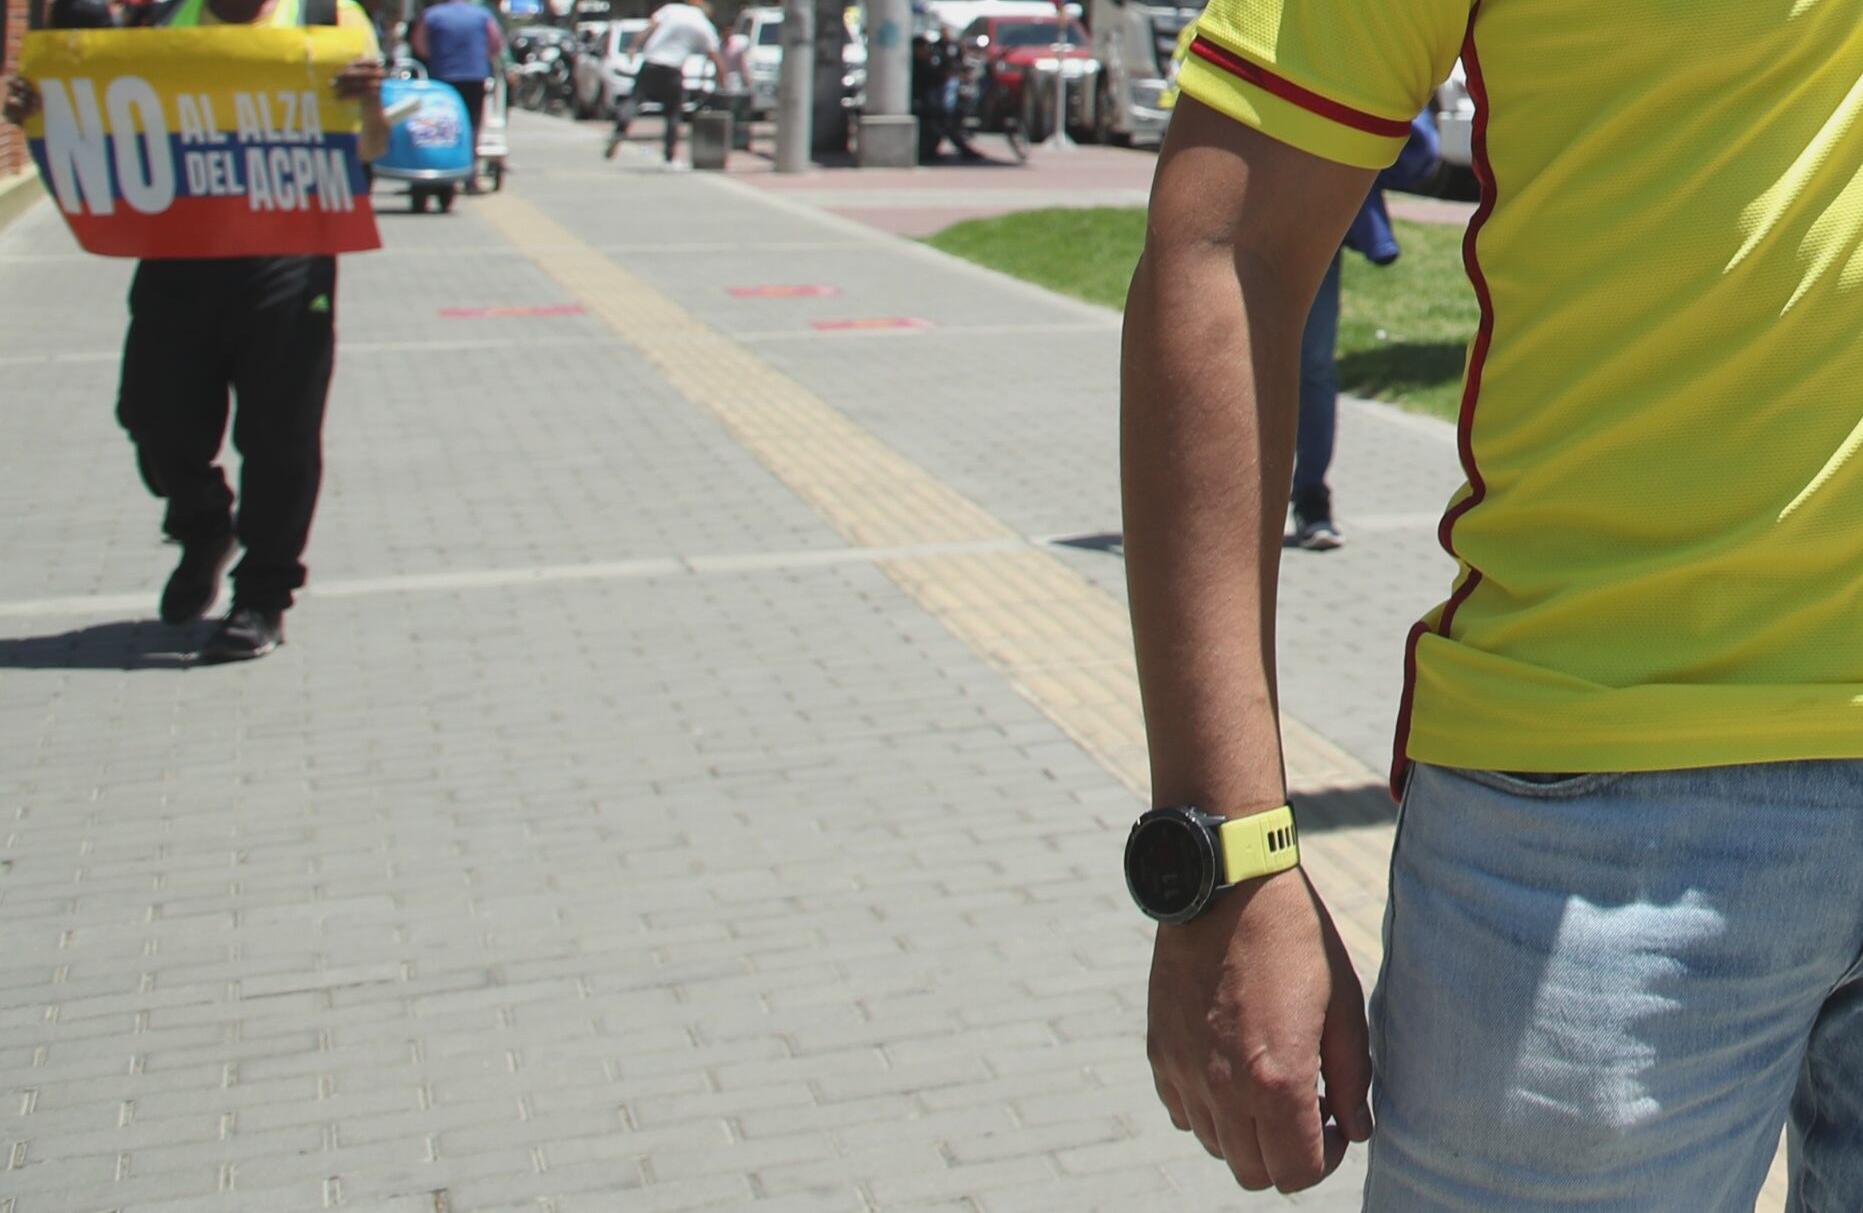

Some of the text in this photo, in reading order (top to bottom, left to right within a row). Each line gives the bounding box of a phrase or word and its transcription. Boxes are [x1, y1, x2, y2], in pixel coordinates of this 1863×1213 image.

[40, 75, 177, 216] NO
[177, 91, 326, 144] AL ALZA
[184, 147, 355, 213] DEL ACPM
